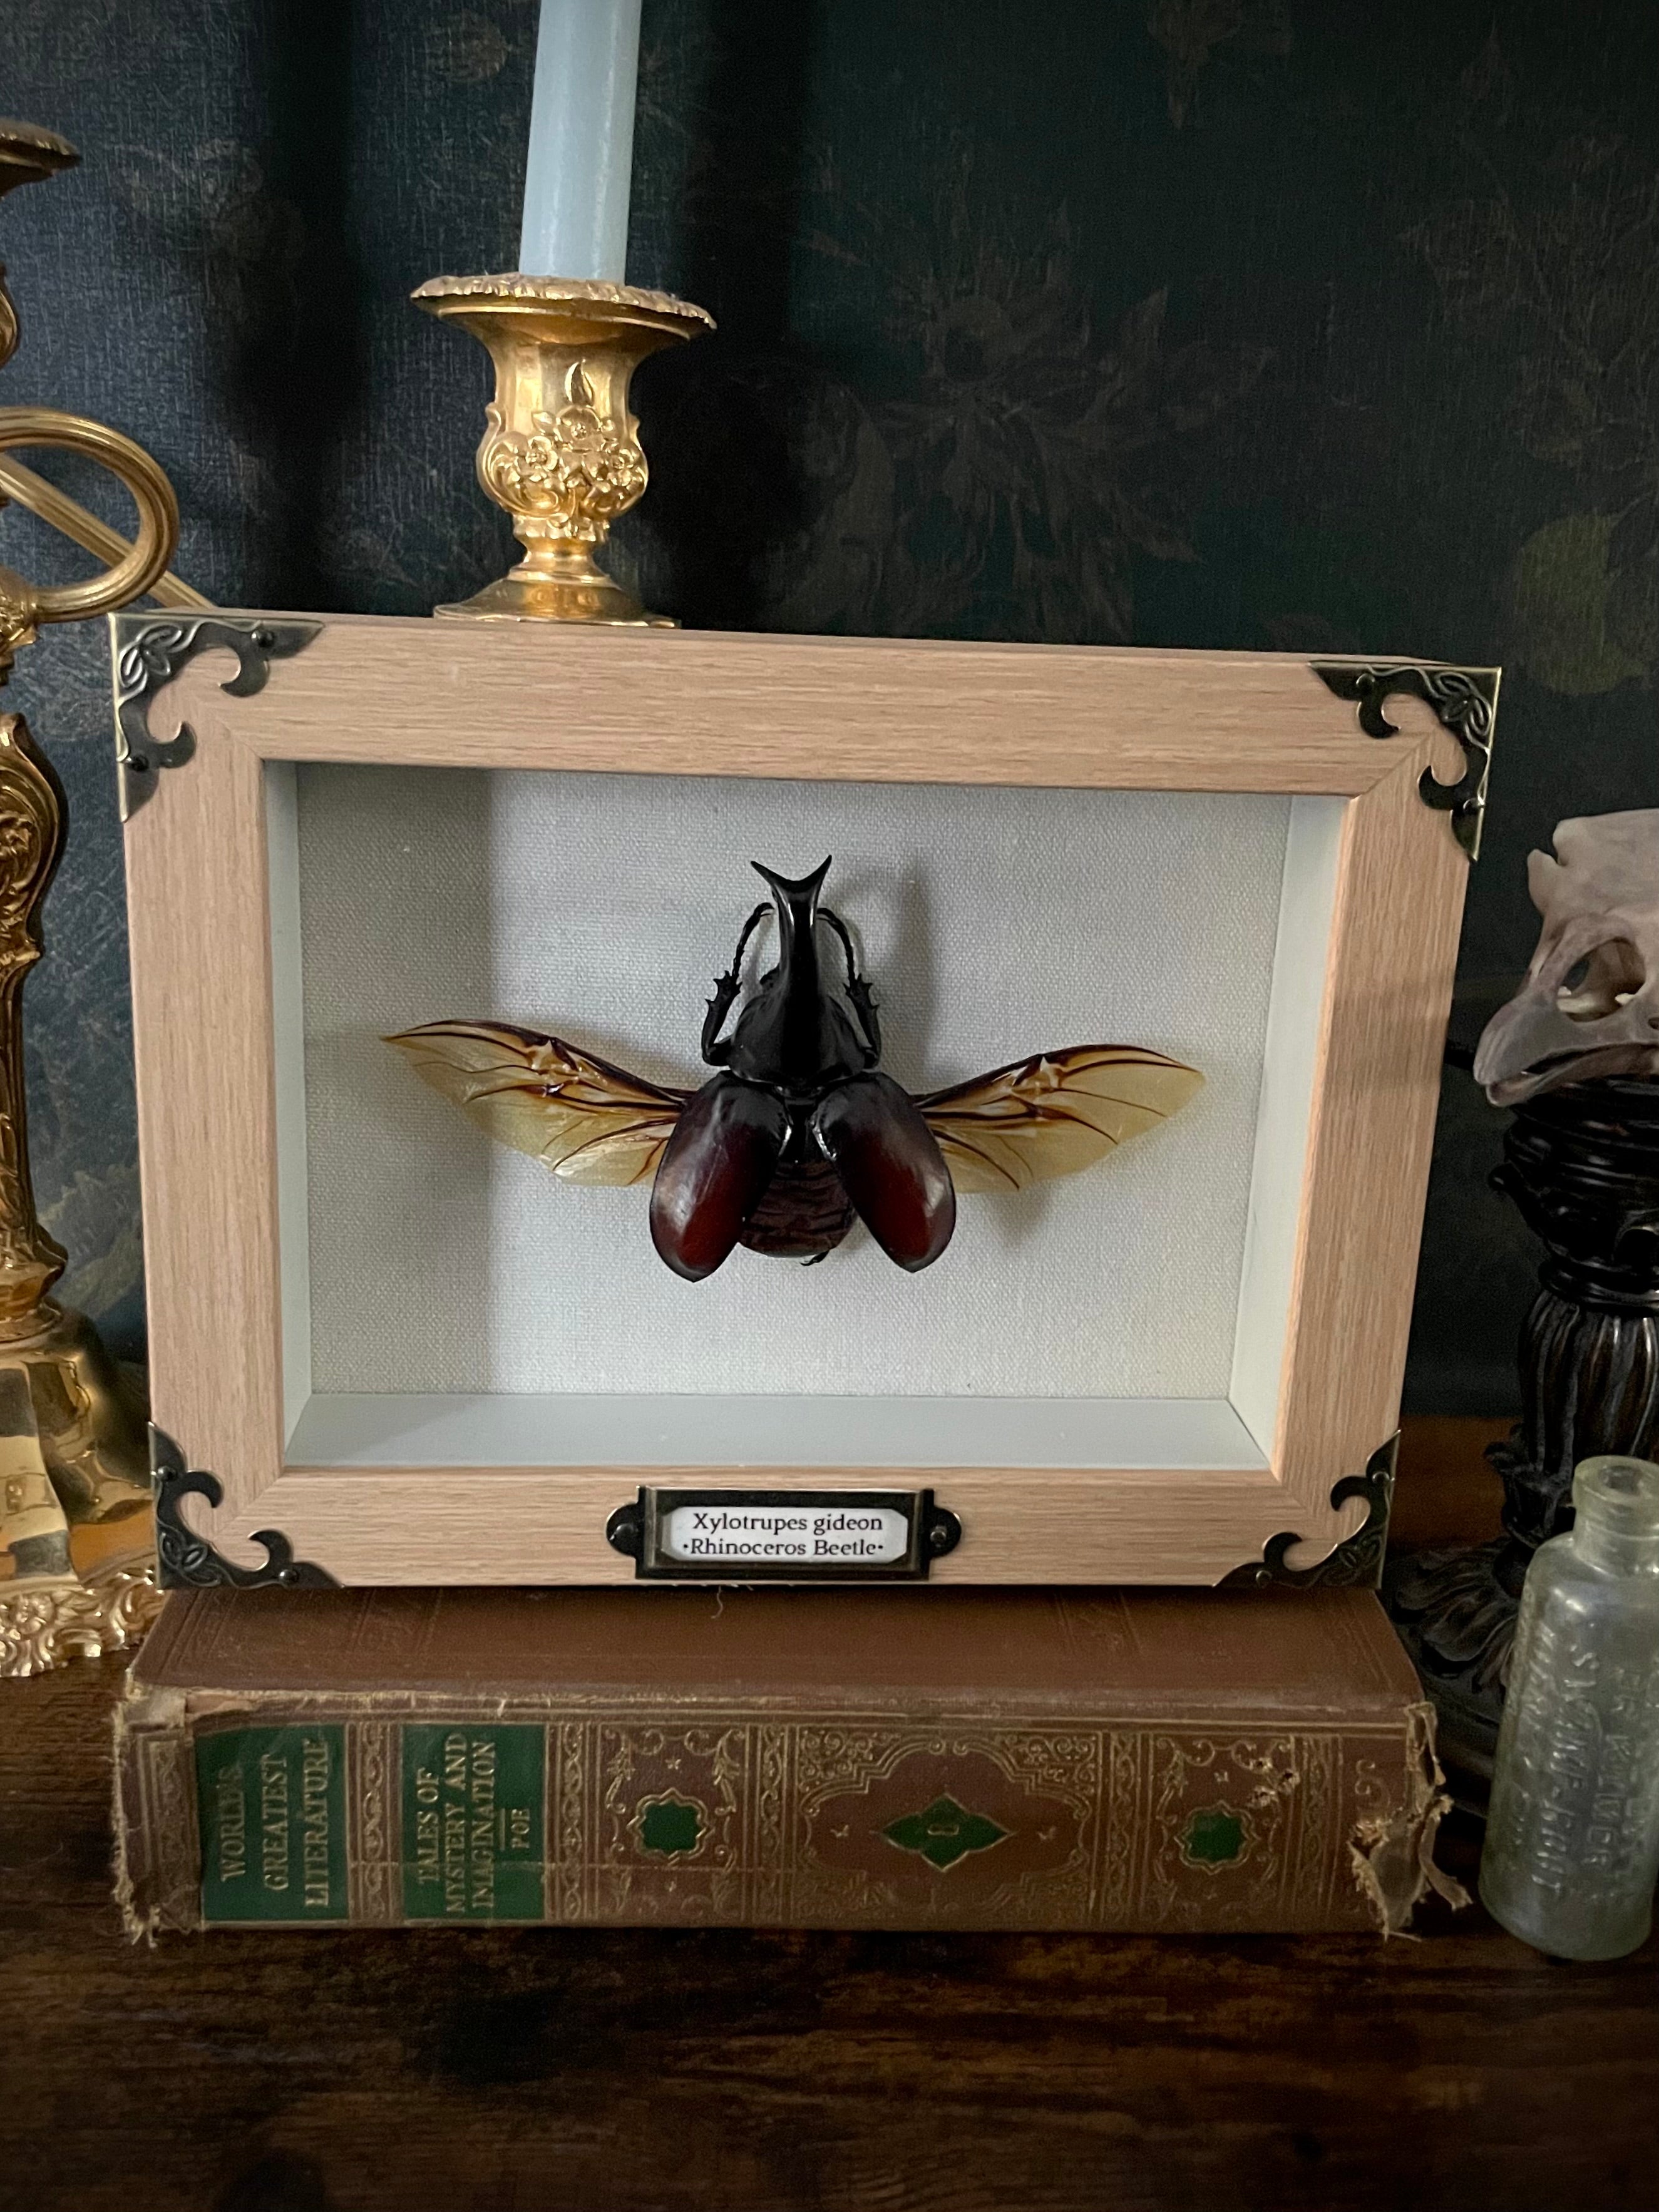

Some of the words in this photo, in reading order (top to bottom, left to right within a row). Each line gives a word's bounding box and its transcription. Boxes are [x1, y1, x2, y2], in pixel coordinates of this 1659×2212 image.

[693, 1513, 807, 1535] Xylotrupes
[813, 1513, 883, 1535] gideon
[417, 1766, 439, 1803] OF
[445, 1733, 467, 1791] AND
[260, 1754, 289, 1891] GREATEST
[302, 1738, 329, 1907] LITERATURE
[418, 1811, 439, 1885] TALES
[445, 1803, 466, 1913] MYSTERY
[472, 1742, 496, 1908] IMAGINATION
[511, 1808, 531, 1849] POE
